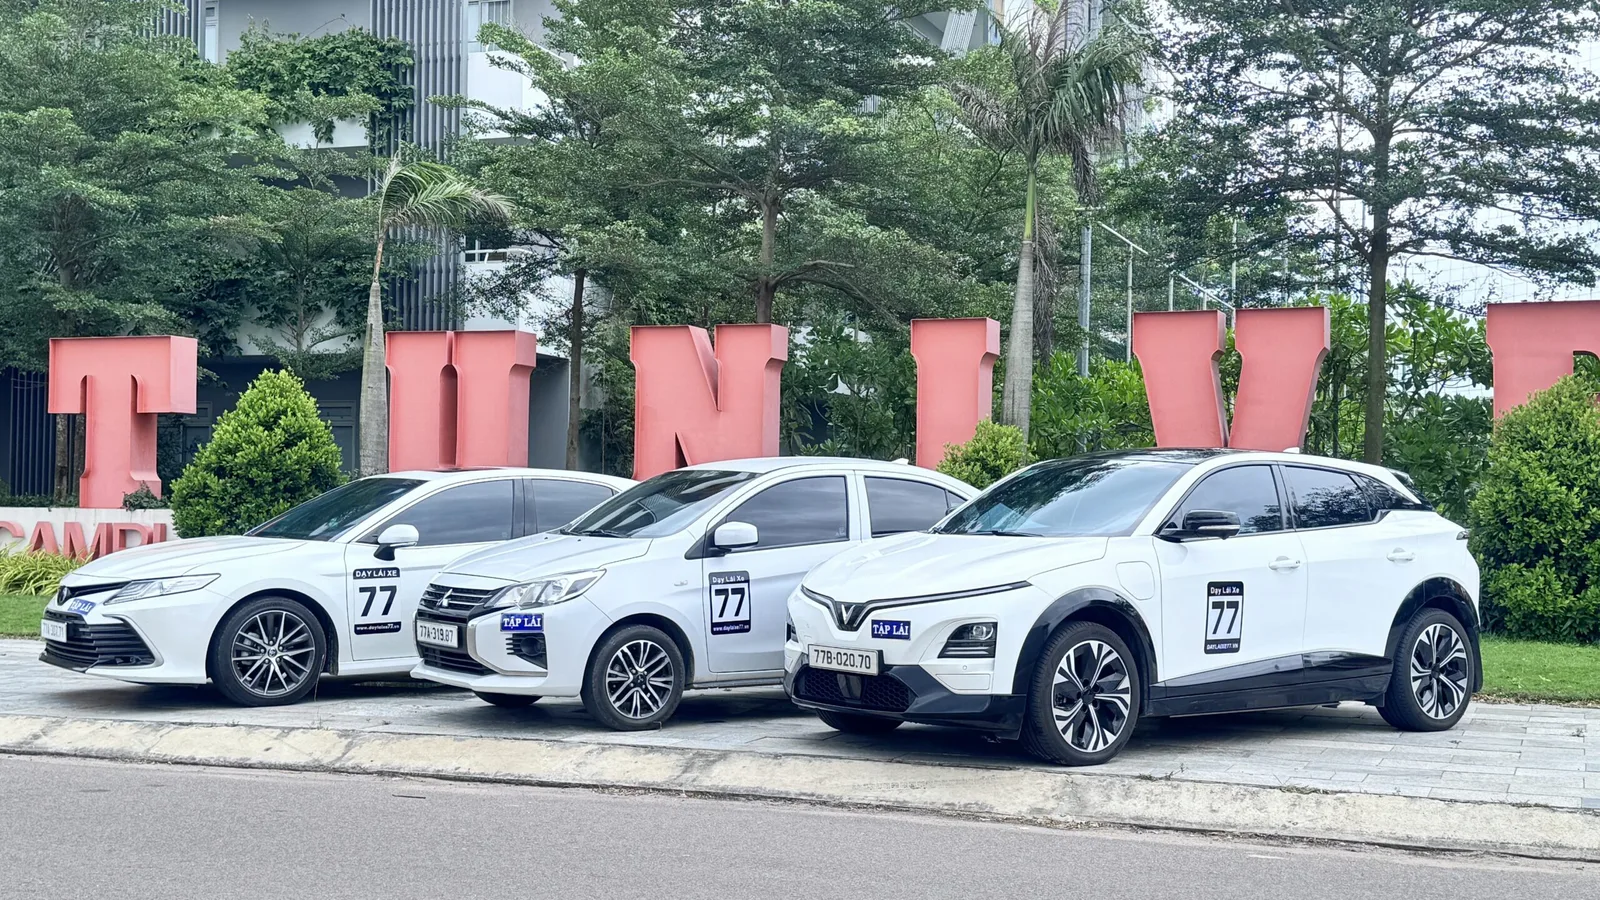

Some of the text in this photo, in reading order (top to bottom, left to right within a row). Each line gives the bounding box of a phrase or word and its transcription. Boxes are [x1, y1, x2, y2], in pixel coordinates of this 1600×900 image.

[385, 300, 1600, 480] UNIV
[0, 521, 167, 563] AMP
[355, 569, 398, 578] DẠY LÁI XE
[359, 585, 397, 617] 77
[715, 588, 745, 618] 77
[503, 616, 541, 629] TẬP LÁI
[873, 622, 909, 636] TẬP LÁI
[1212, 600, 1240, 634] 77
[814, 649, 871, 669] 77B-020.70
